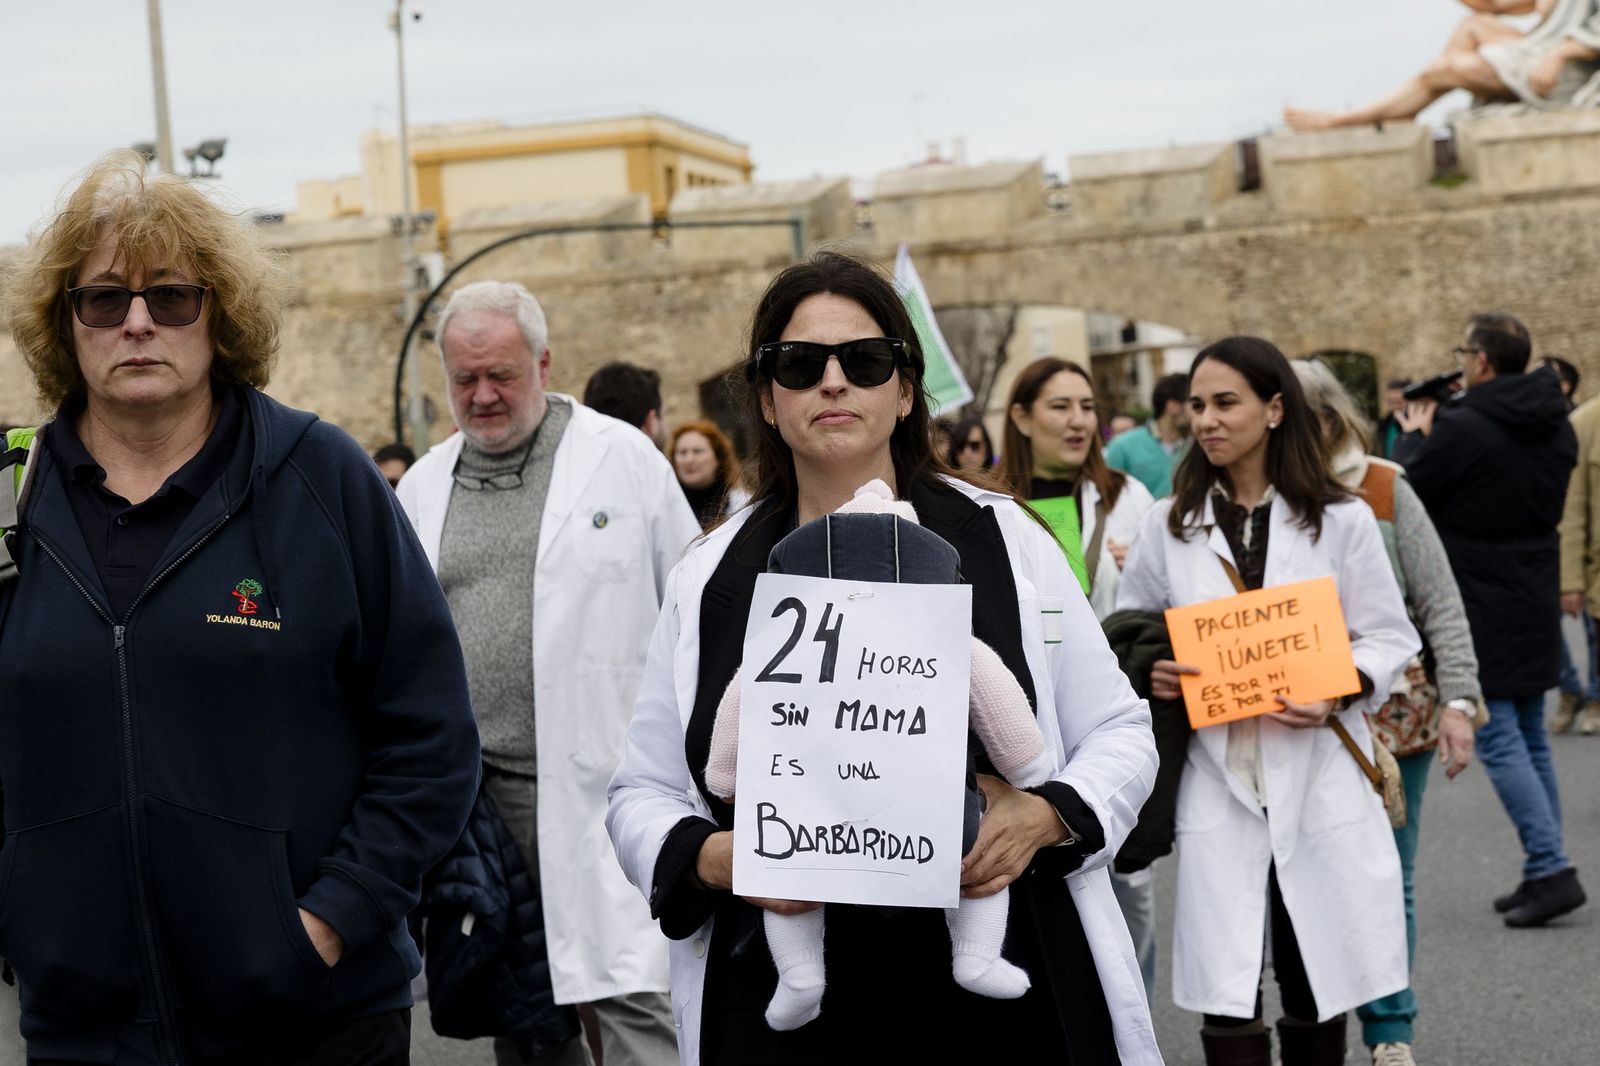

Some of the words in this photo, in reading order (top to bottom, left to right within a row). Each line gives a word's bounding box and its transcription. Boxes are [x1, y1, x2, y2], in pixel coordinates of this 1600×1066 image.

[206, 614, 248, 625] YOLANDA
[249, 618, 281, 630] BARON
[1194, 598, 1301, 642] PACIENTE
[754, 597, 844, 683] 24
[857, 647, 938, 680] HORAS
[1201, 684, 1223, 701] ES
[1226, 677, 1260, 695] POR
[834, 698, 927, 736] MAMA
[1207, 703, 1227, 718] ES
[1232, 694, 1265, 709] POR
[770, 754, 805, 776] ES
[837, 760, 881, 780] UNA
